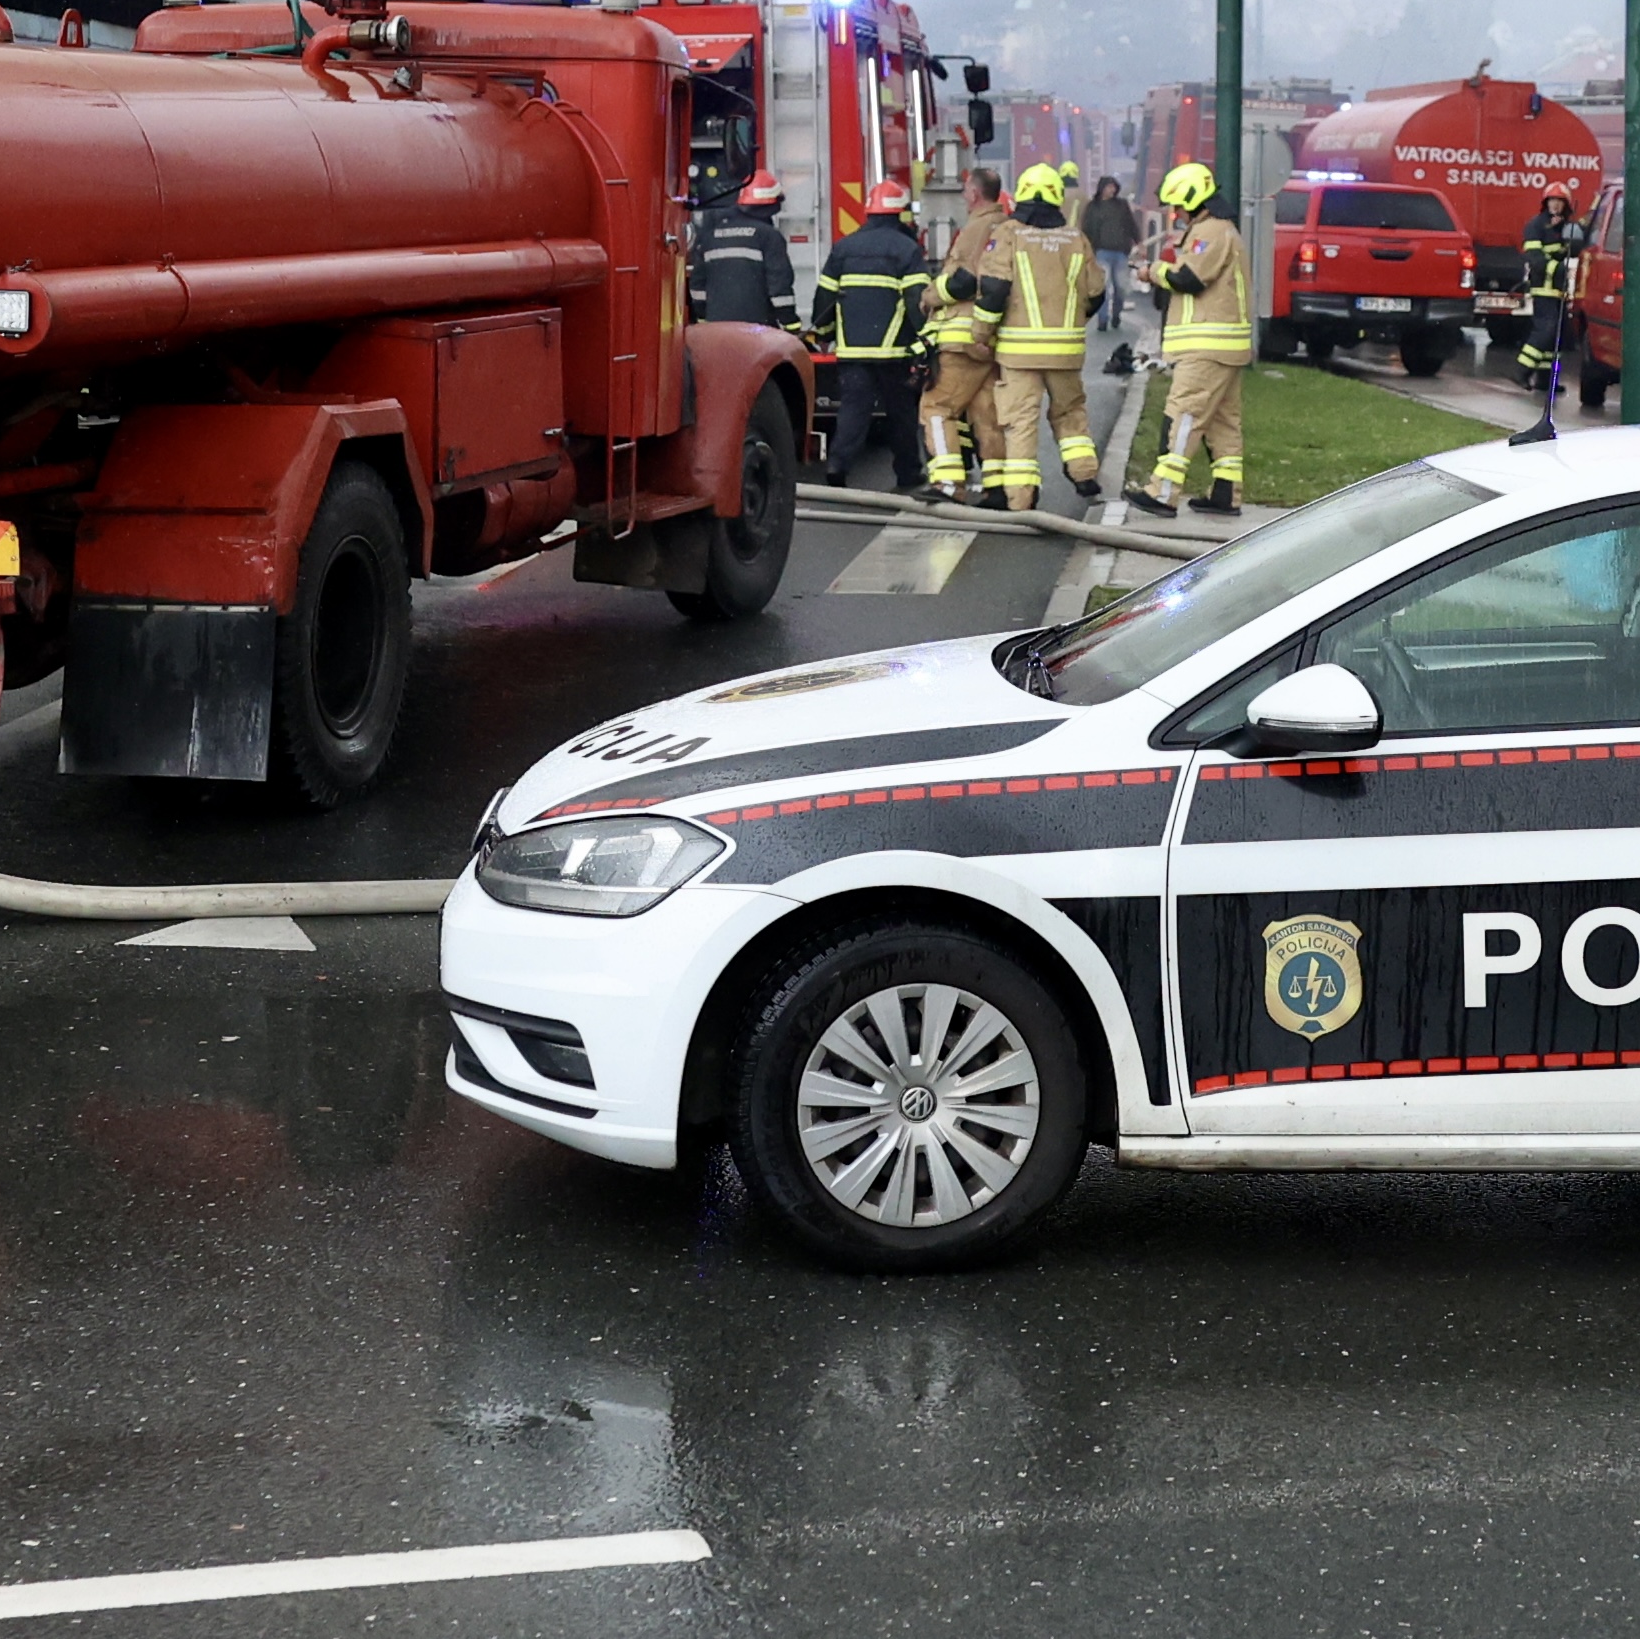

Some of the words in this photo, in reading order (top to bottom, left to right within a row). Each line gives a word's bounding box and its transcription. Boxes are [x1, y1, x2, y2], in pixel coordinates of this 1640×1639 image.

[1522, 151, 1600, 172] VRATNIK
[1446, 168, 1547, 189] SARAJEVO
[1269, 923, 1306, 944] KANTON
[1306, 922, 1354, 945] SARAJEVO
[1276, 937, 1346, 960] POLICIJA
